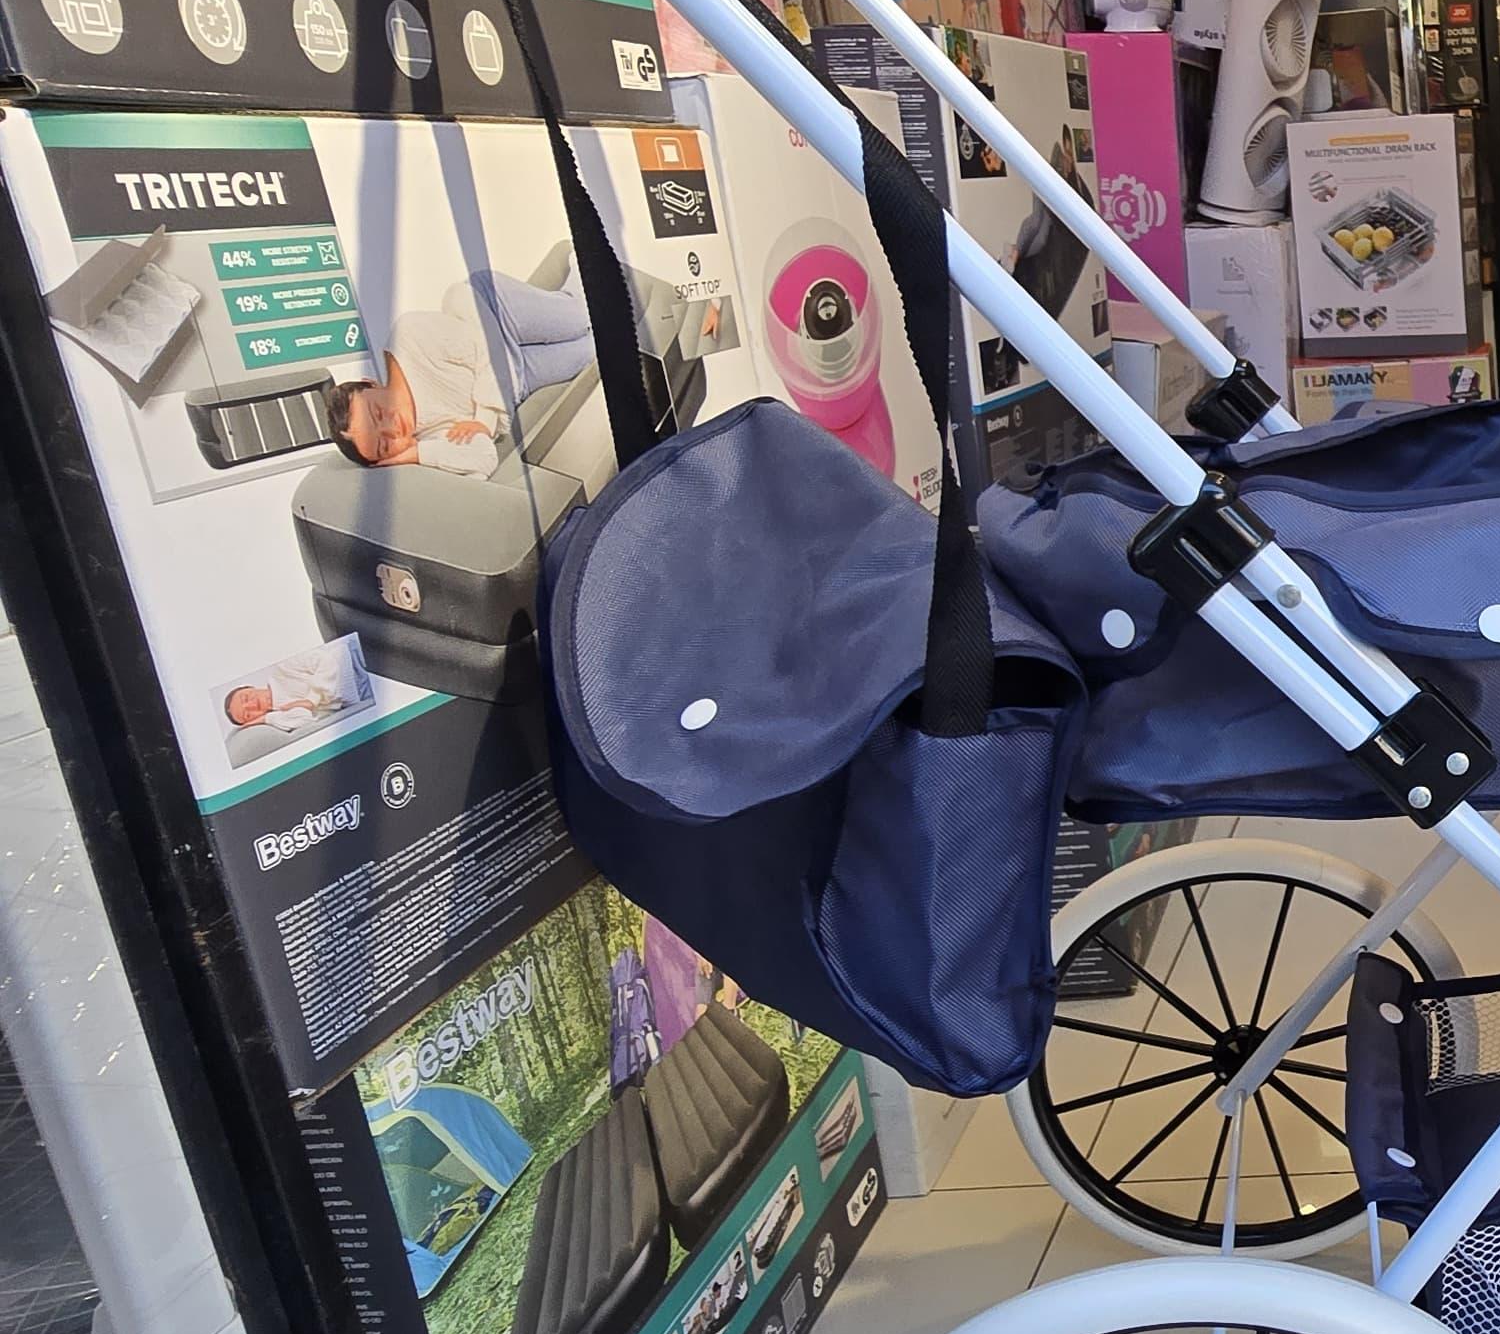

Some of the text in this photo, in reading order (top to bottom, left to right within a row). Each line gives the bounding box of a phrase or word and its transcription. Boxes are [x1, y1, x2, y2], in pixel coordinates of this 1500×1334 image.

[1305, 142, 1437, 158] MULTIFUNCTIONAL DRAIN RACK
[116, 171, 285, 212] TRITECH
[222, 250, 256, 268] 44%
[674, 280, 721, 300] SOFT TOP
[235, 294, 268, 313] 19%
[249, 338, 281, 357] 18%
[254, 795, 361, 871] Bestway
[383, 956, 535, 1112] Bestway
[733, 1250, 744, 1269] 2
